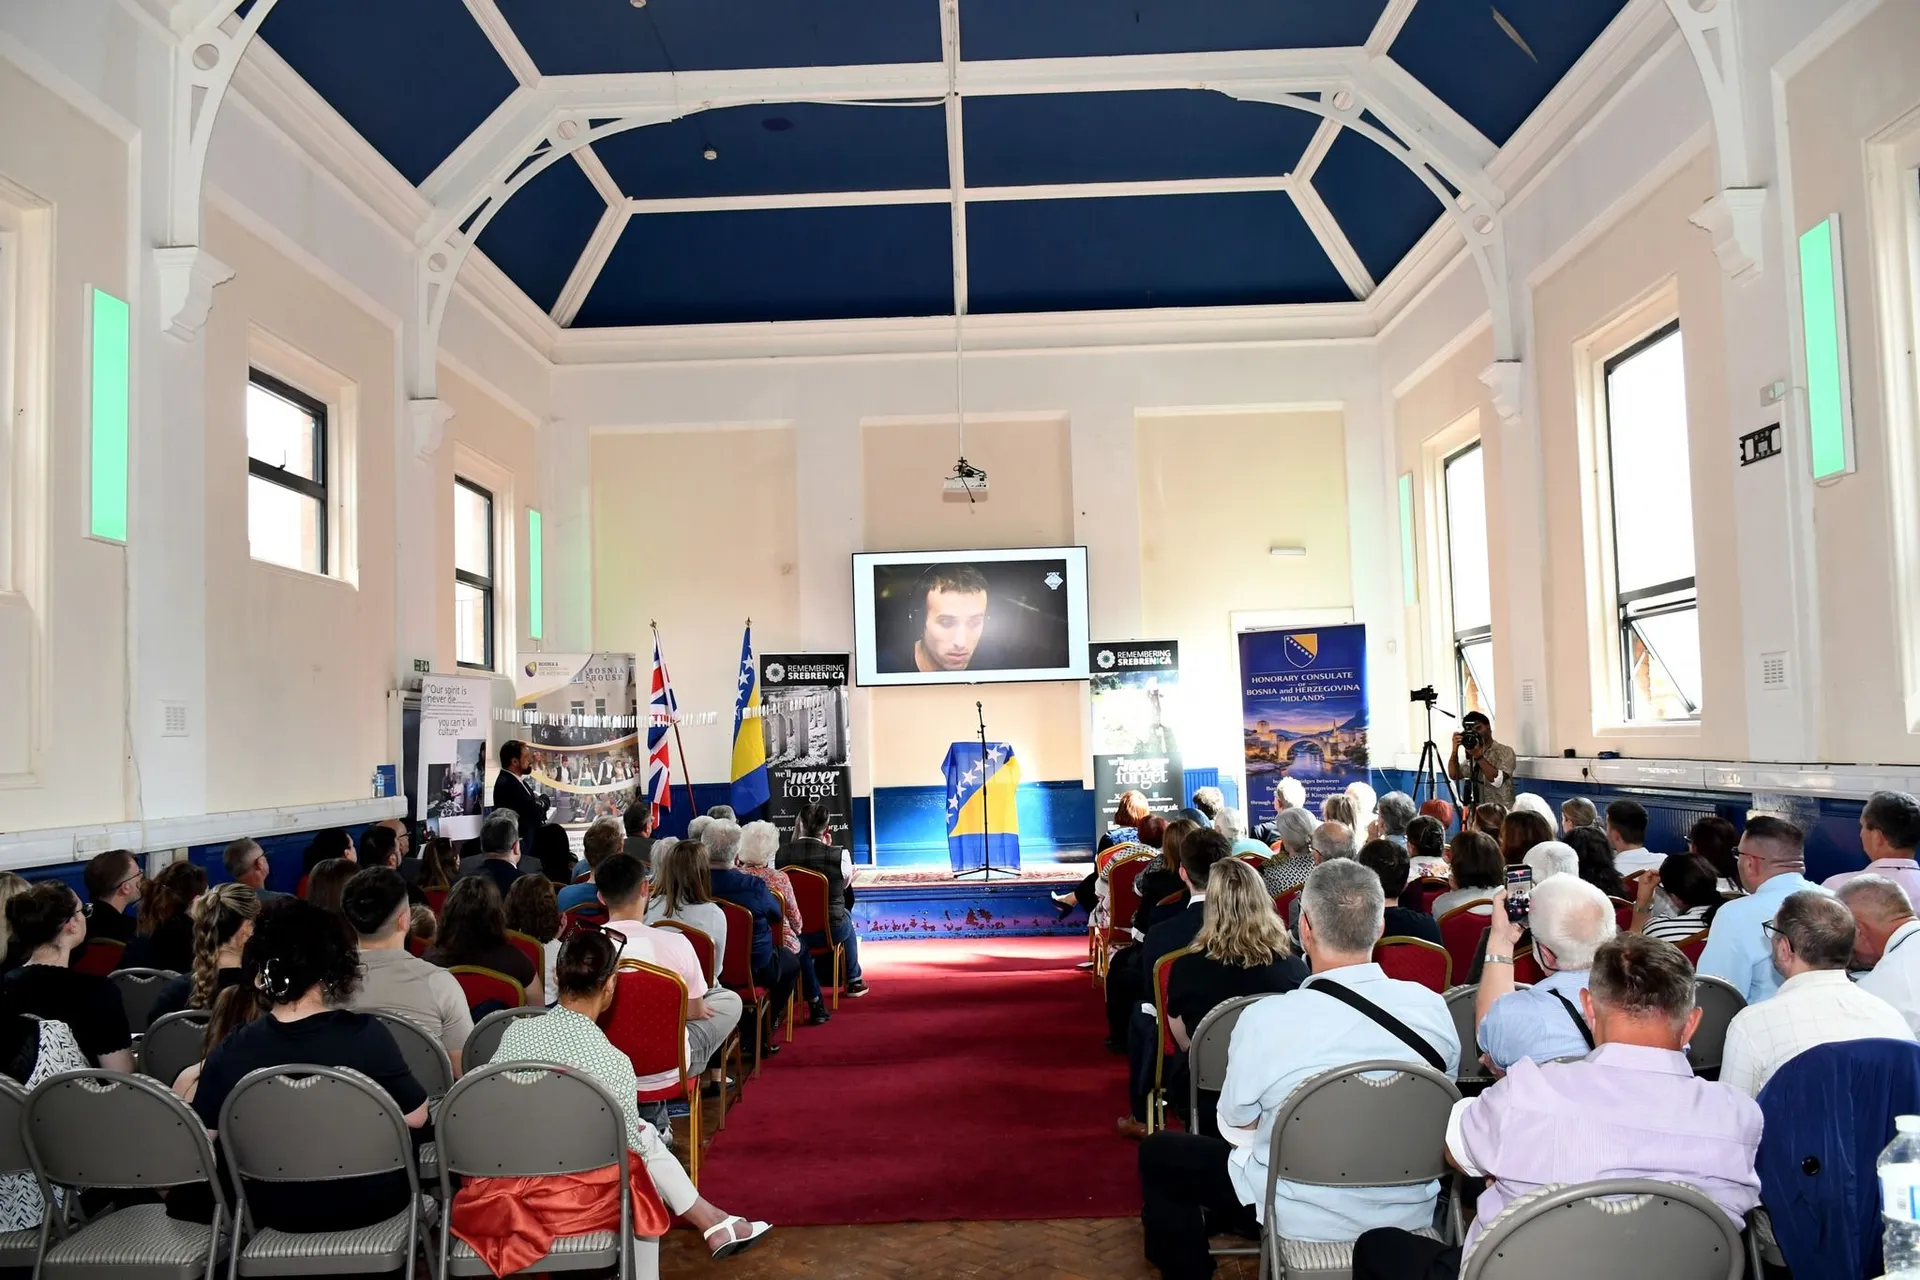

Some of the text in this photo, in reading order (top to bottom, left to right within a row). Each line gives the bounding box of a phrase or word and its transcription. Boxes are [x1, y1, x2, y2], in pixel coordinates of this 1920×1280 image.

[1117, 650, 1171, 658] REMEMBERING
[1117, 657, 1172, 666] SREBRENICA
[787, 664, 845, 672] REMEMBERING
[787, 672, 845, 680] SREBRENICA
[1251, 671, 1353, 684] HONORARY CONSULATE
[461, 686, 467, 696] is
[1246, 688, 1277, 696] BOSNIA
[1295, 684, 1360, 693] HERZEGOVINA
[427, 695, 447, 703] never
[1280, 694, 1325, 703] MIDLANDS
[438, 719, 450, 728] you
[774, 769, 840, 785] we'll never
[1115, 765, 1169, 790] forget
[782, 779, 839, 804] forget
